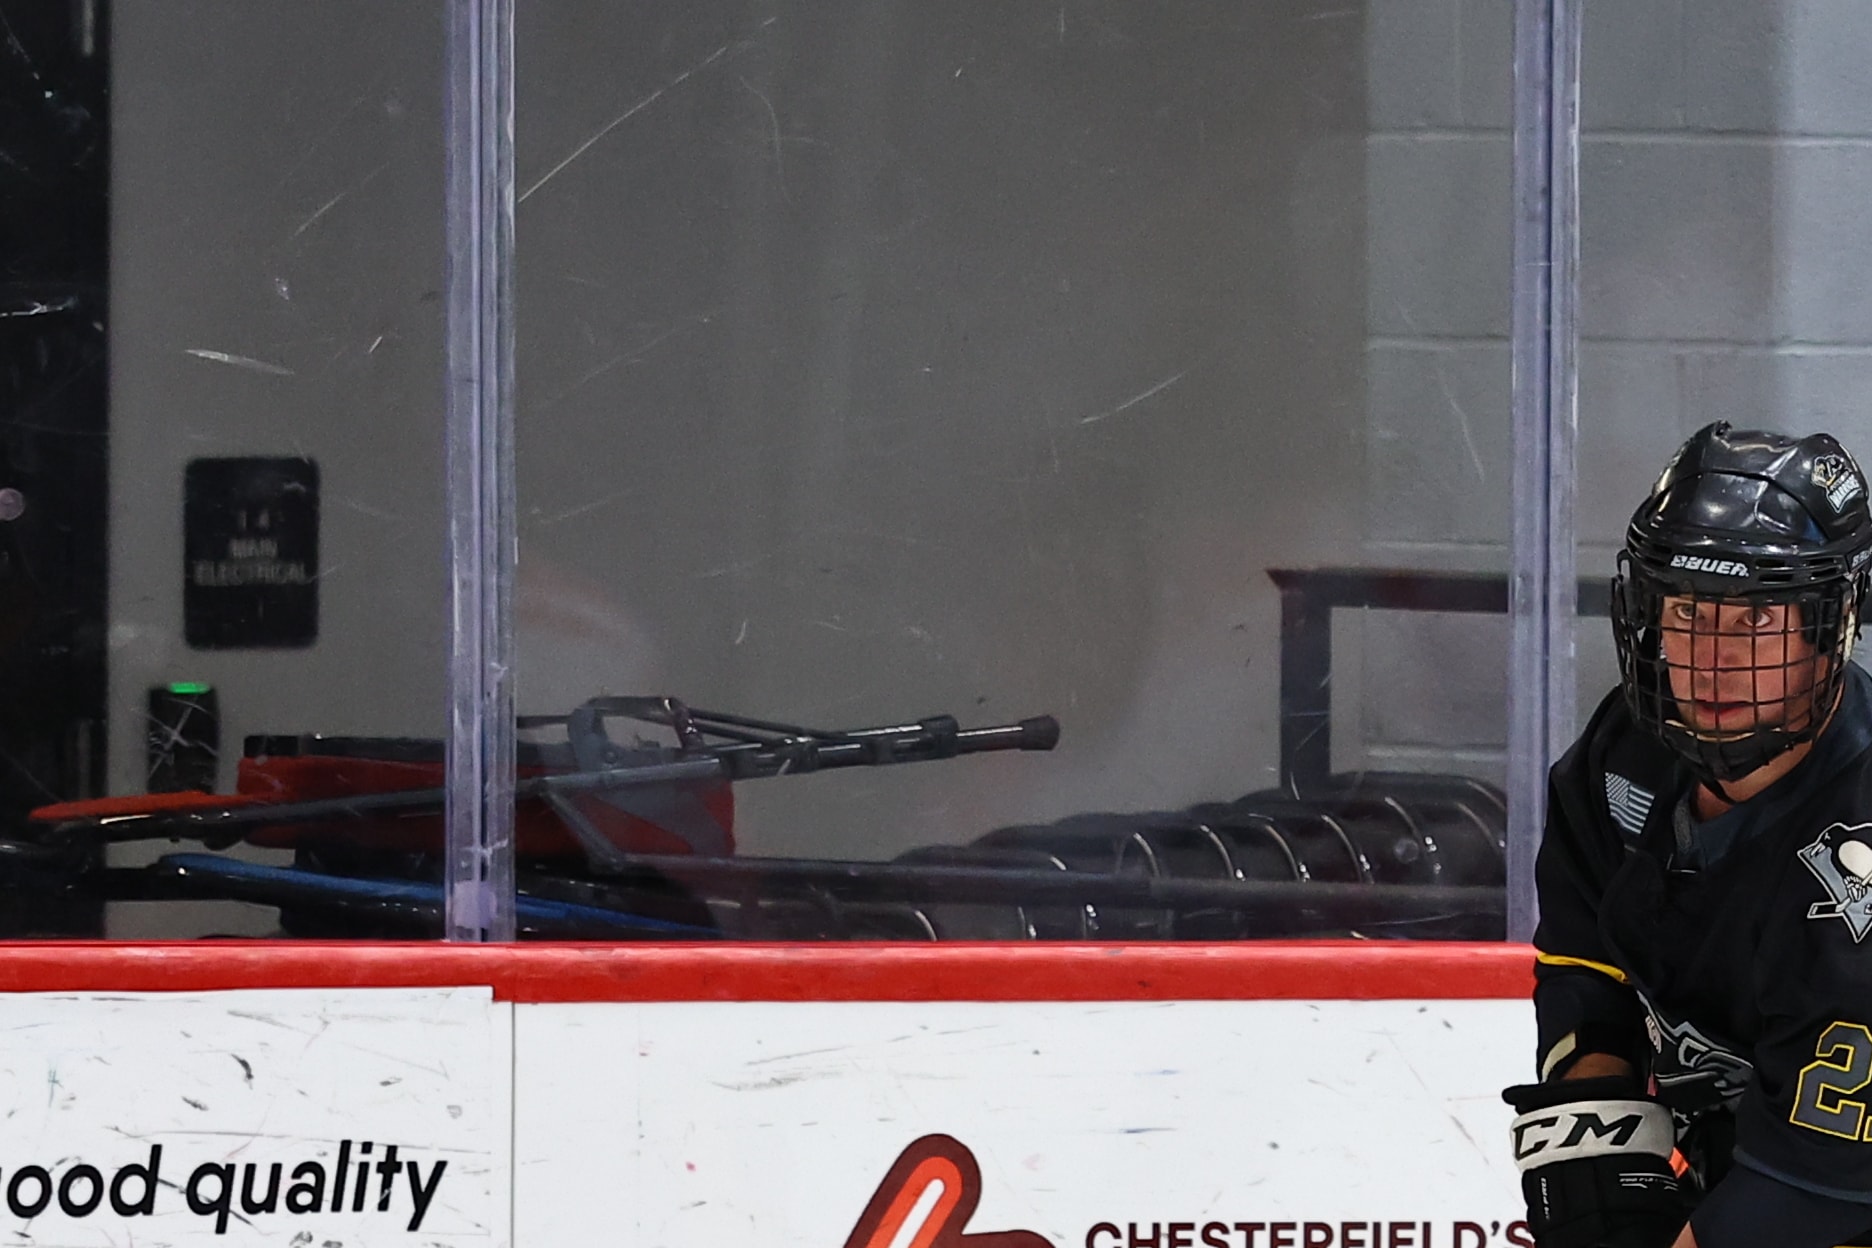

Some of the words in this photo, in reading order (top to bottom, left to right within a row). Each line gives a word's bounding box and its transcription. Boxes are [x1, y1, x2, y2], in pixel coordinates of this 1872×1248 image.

[1669, 554, 1750, 578] BAUER
[1512, 1112, 1643, 1162] CM
[0, 1145, 163, 1218] ood
[186, 1140, 447, 1234] quality
